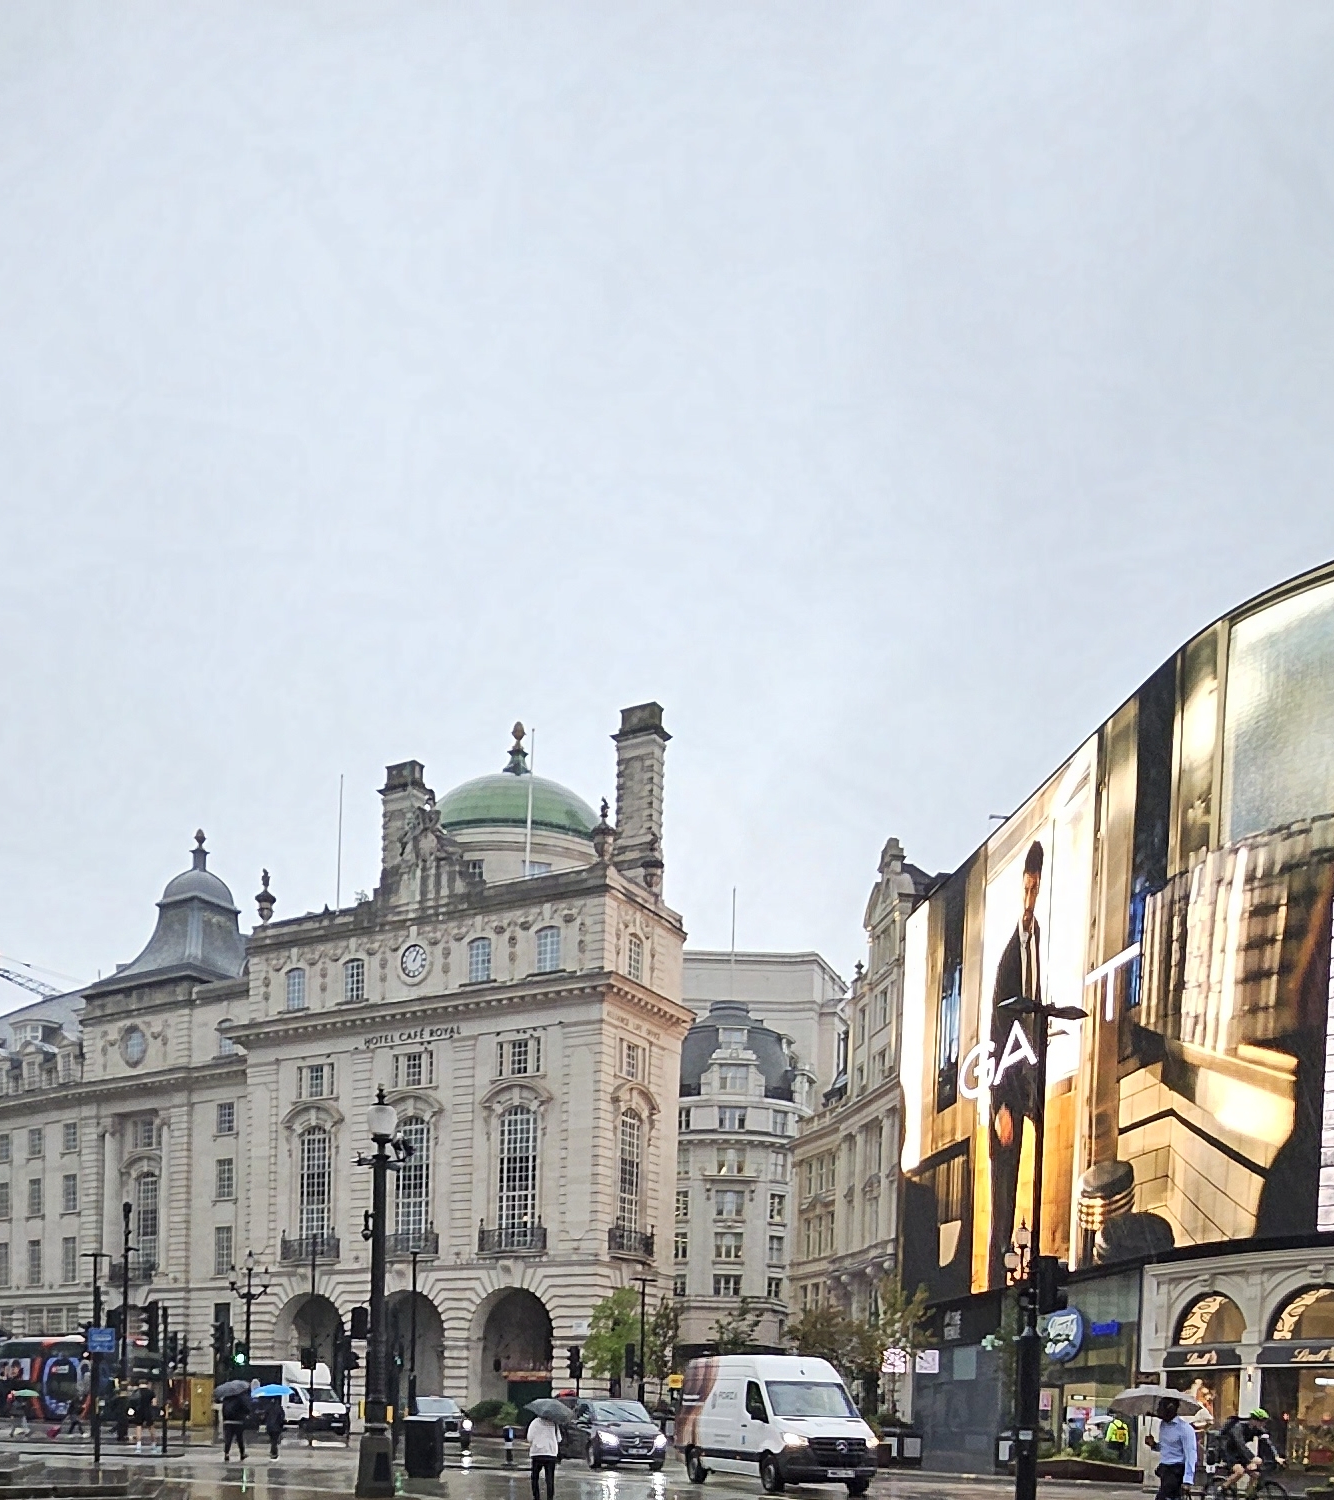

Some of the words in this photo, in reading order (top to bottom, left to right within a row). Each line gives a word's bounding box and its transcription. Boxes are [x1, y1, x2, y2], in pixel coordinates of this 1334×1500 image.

[364, 1034, 394, 1046] HOTEL
[398, 1027, 425, 1042] CAFÉ
[429, 1025, 461, 1038] ROYAL
